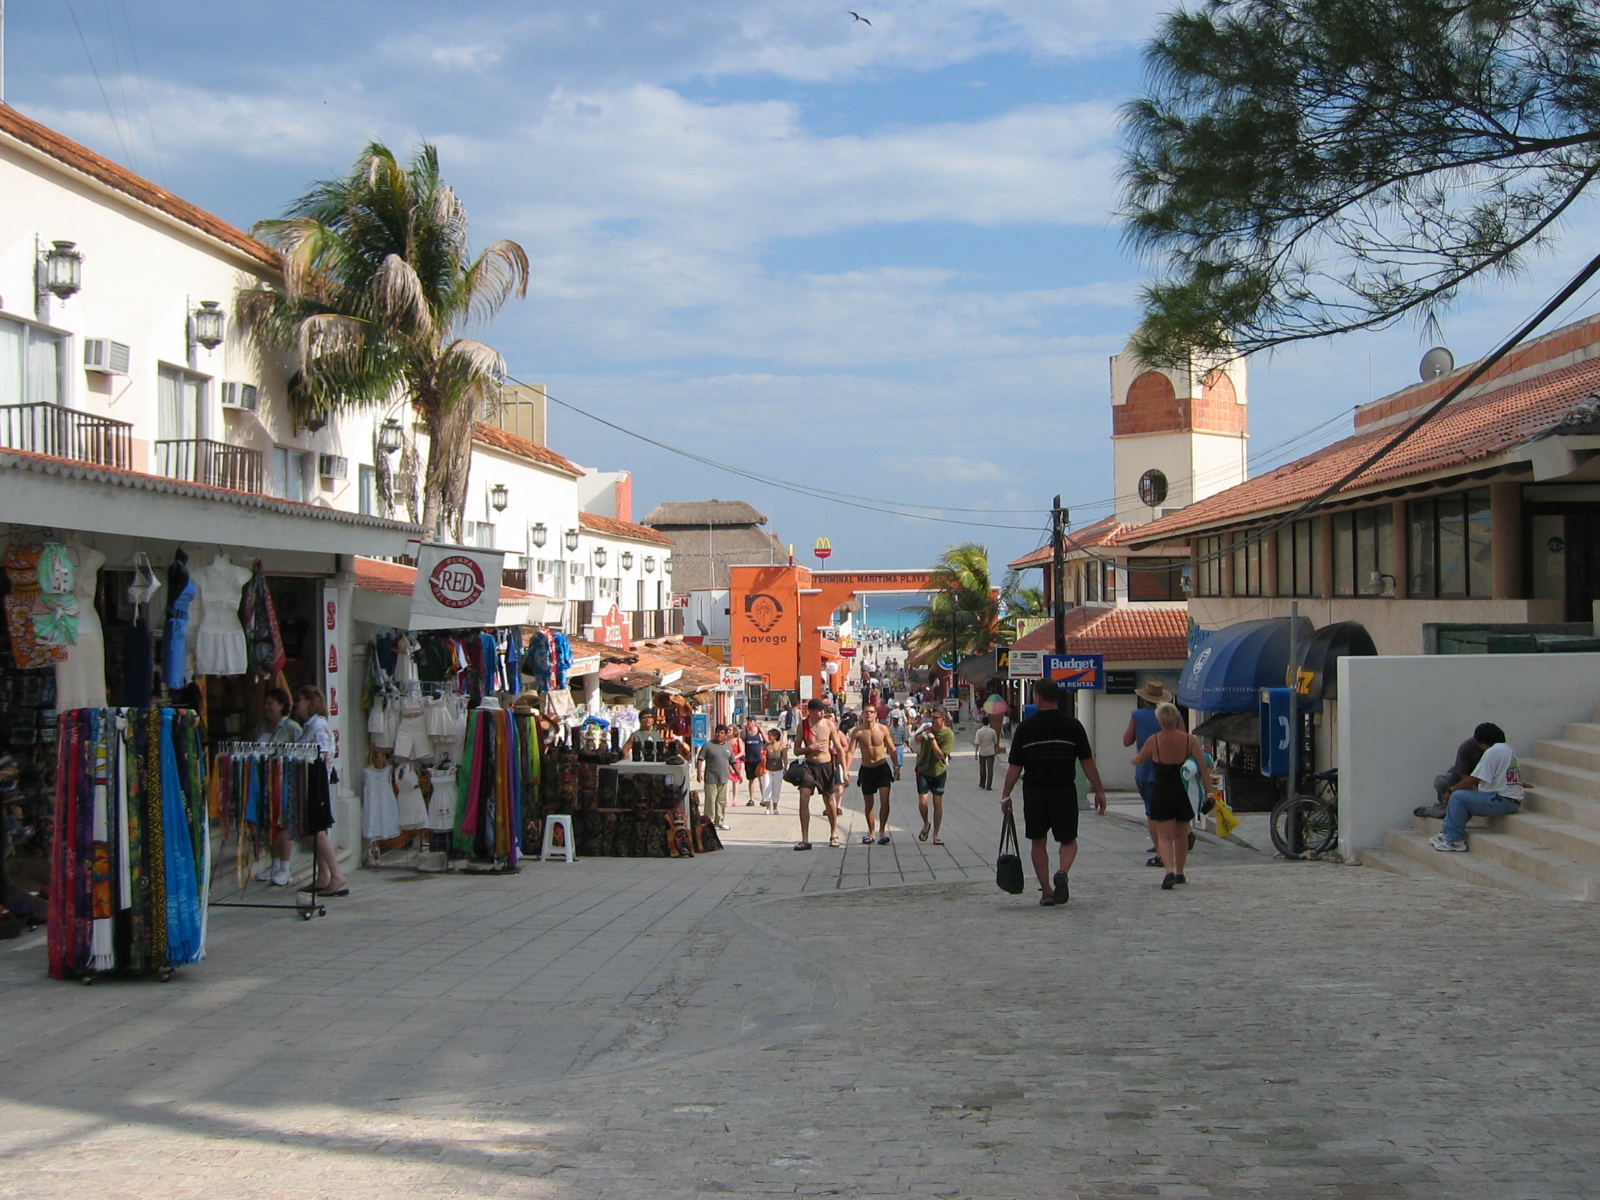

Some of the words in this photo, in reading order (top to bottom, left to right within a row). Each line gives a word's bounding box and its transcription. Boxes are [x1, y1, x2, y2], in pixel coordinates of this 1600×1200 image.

[446, 558, 473, 567] PLAYA
[439, 570, 474, 593] RED
[814, 575, 855, 584] TERMINAL
[857, 574, 898, 583] MARITIMA
[900, 574, 926, 583] PLAYA
[445, 593, 479, 606] CARMEN
[742, 636, 787, 645] navega
[1050, 658, 1095, 671] Budget
[1067, 680, 1095, 688] RENTAL
